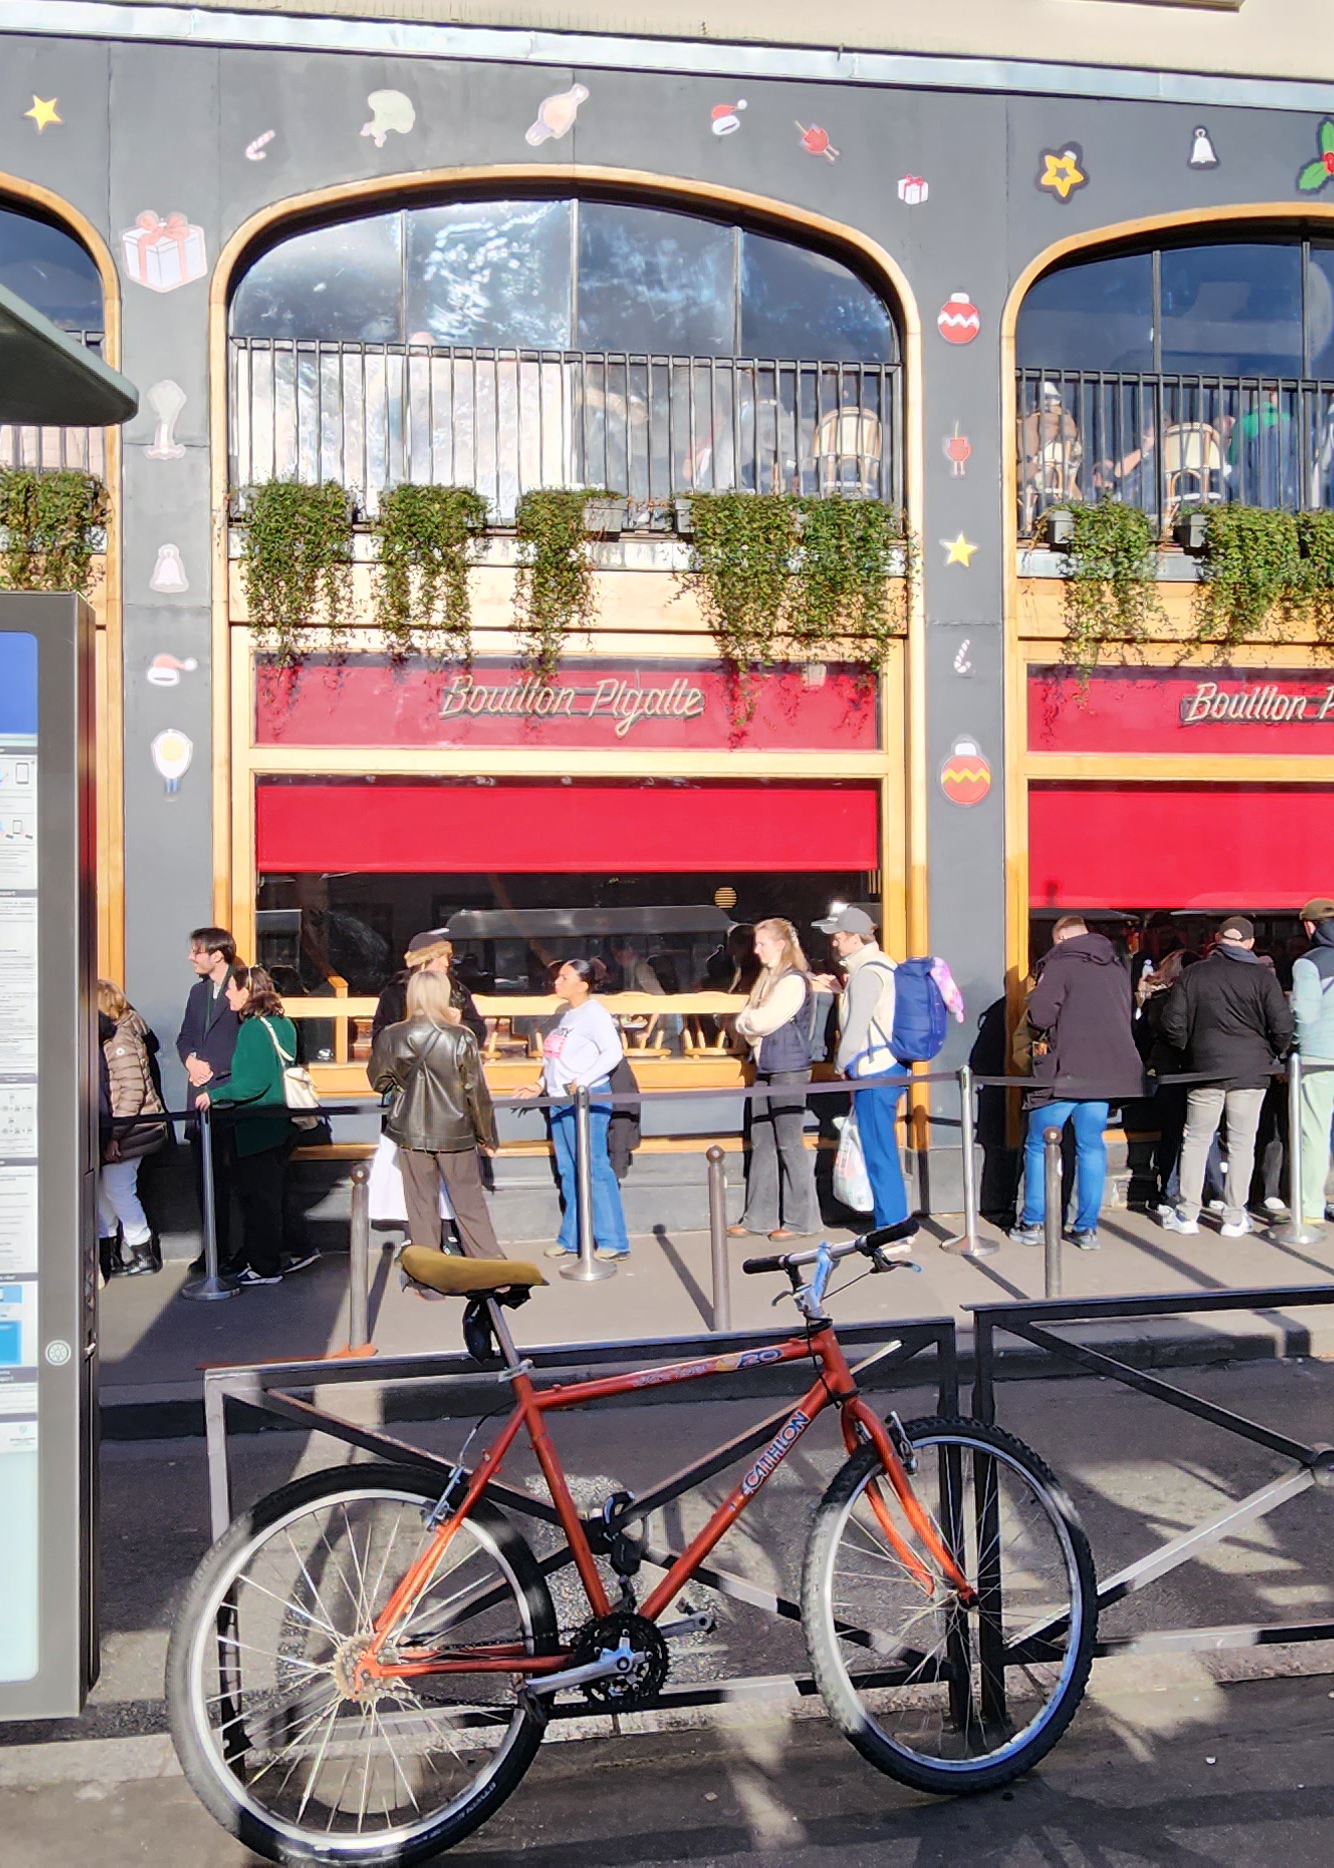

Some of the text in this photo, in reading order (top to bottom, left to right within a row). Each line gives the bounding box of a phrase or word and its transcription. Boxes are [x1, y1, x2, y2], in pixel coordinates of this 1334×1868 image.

[439, 674, 704, 738] Bouillon Pigalle
[1184, 682, 1308, 722] Bouillon
[741, 1408, 811, 1496] CATHLON
